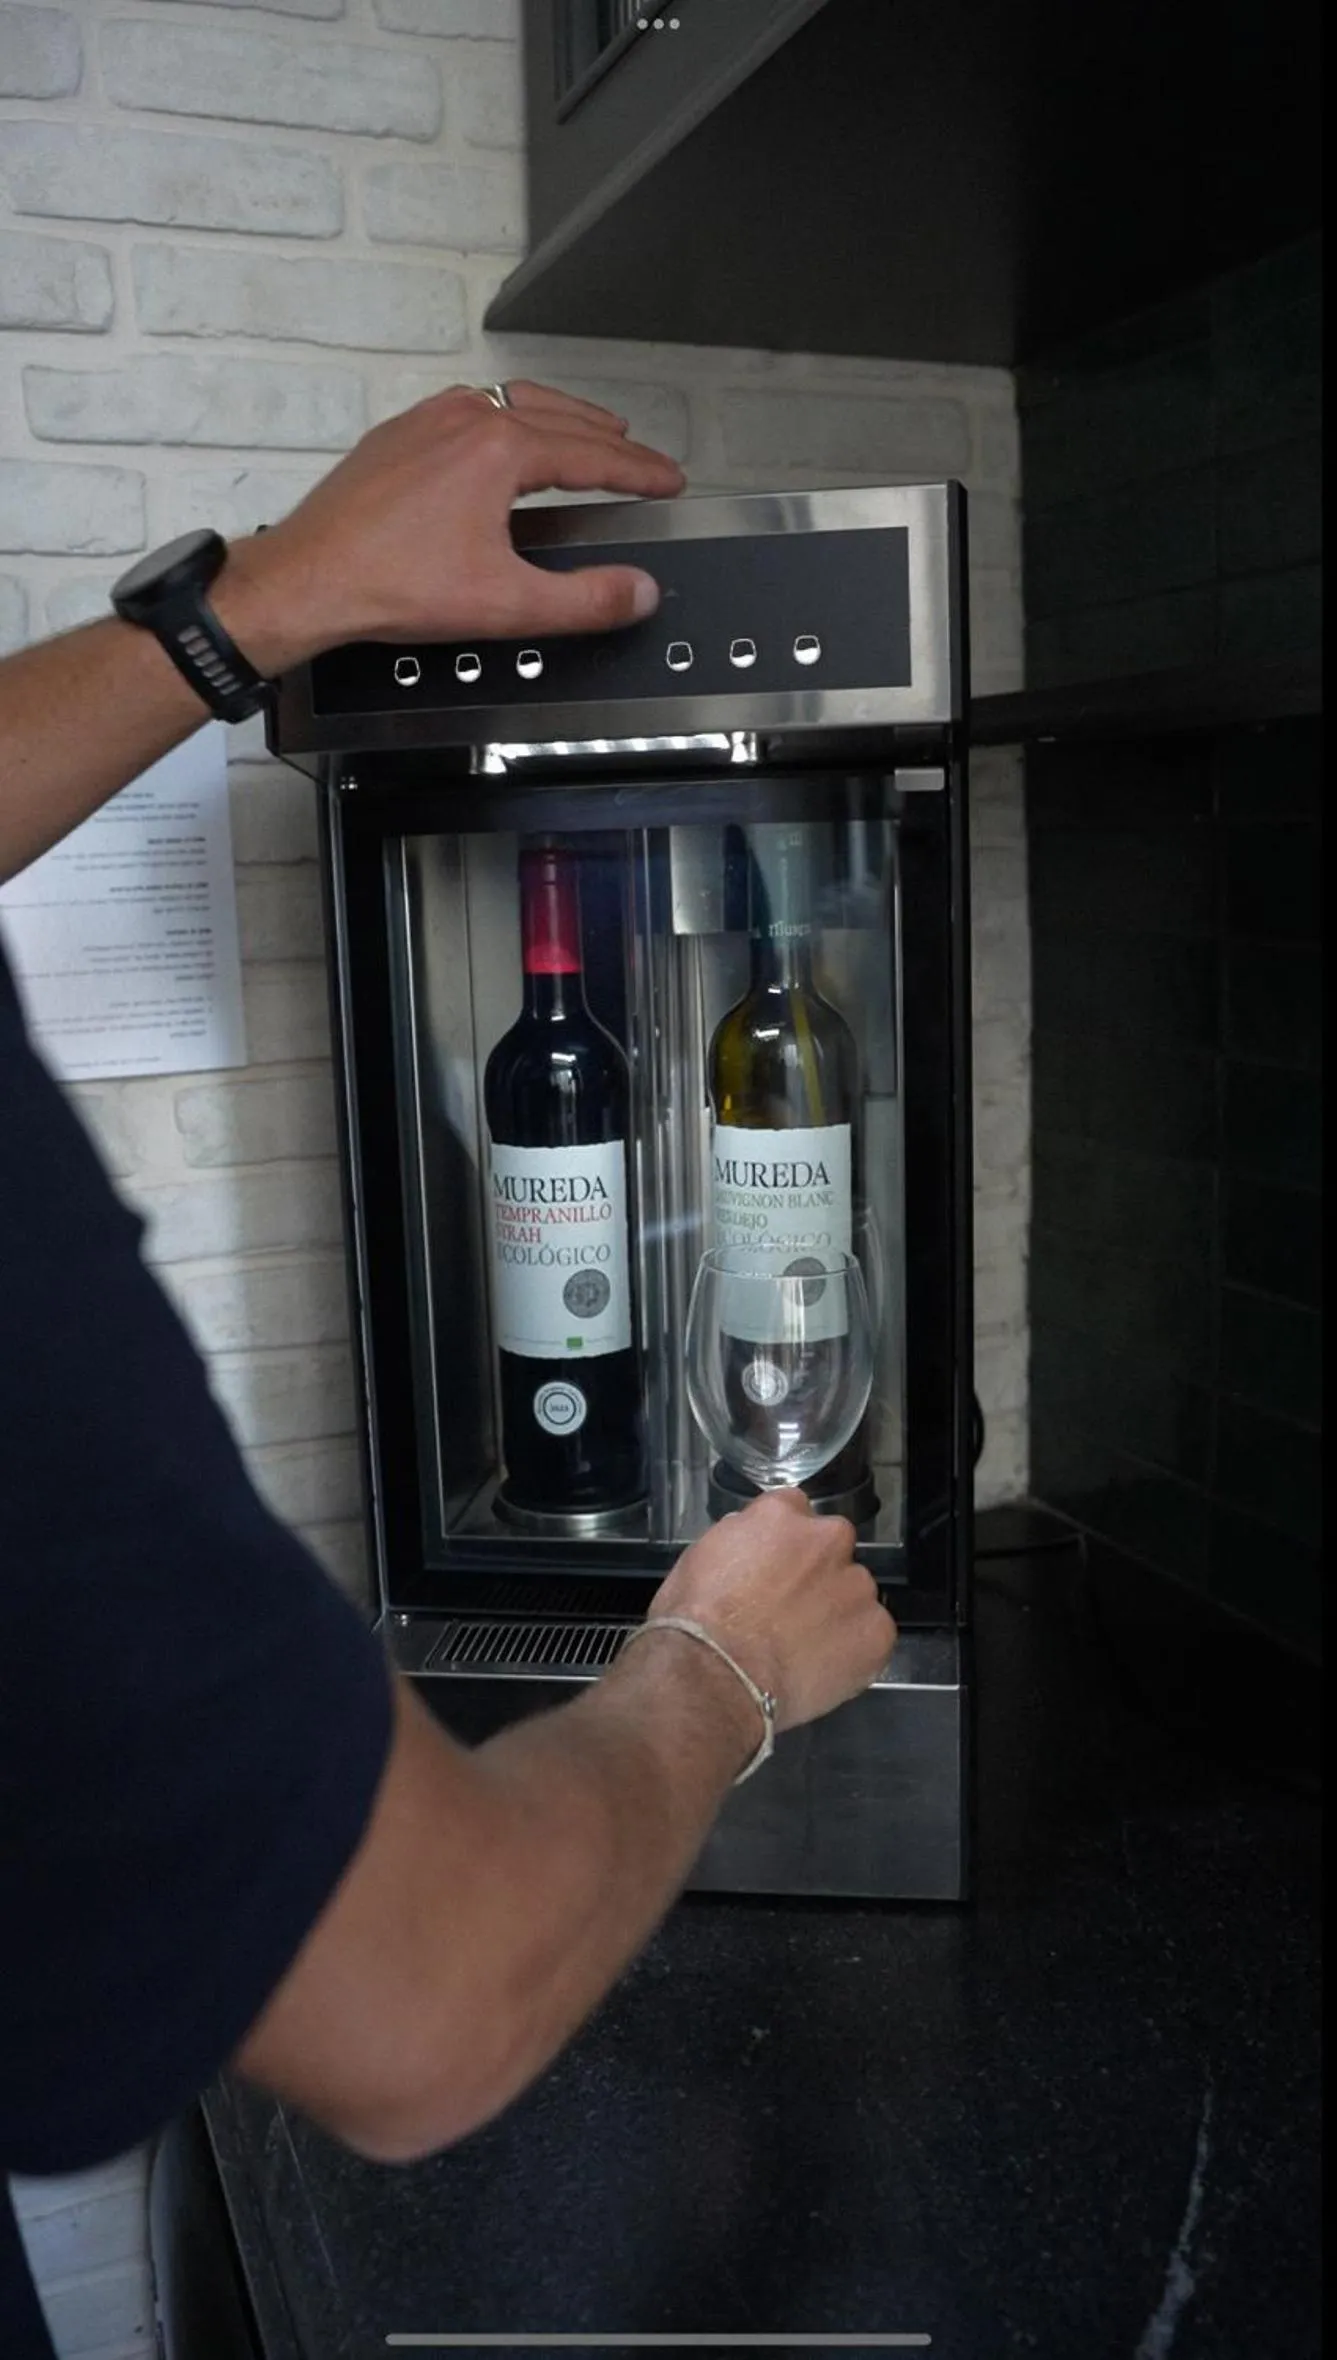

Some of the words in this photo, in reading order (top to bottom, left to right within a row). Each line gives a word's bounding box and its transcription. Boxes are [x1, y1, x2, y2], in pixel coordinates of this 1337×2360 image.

[493, 1173, 609, 1203] MUREDA
[715, 1157, 831, 1189] MUREDA
[496, 1202, 612, 1224] TEMPRANILLO
